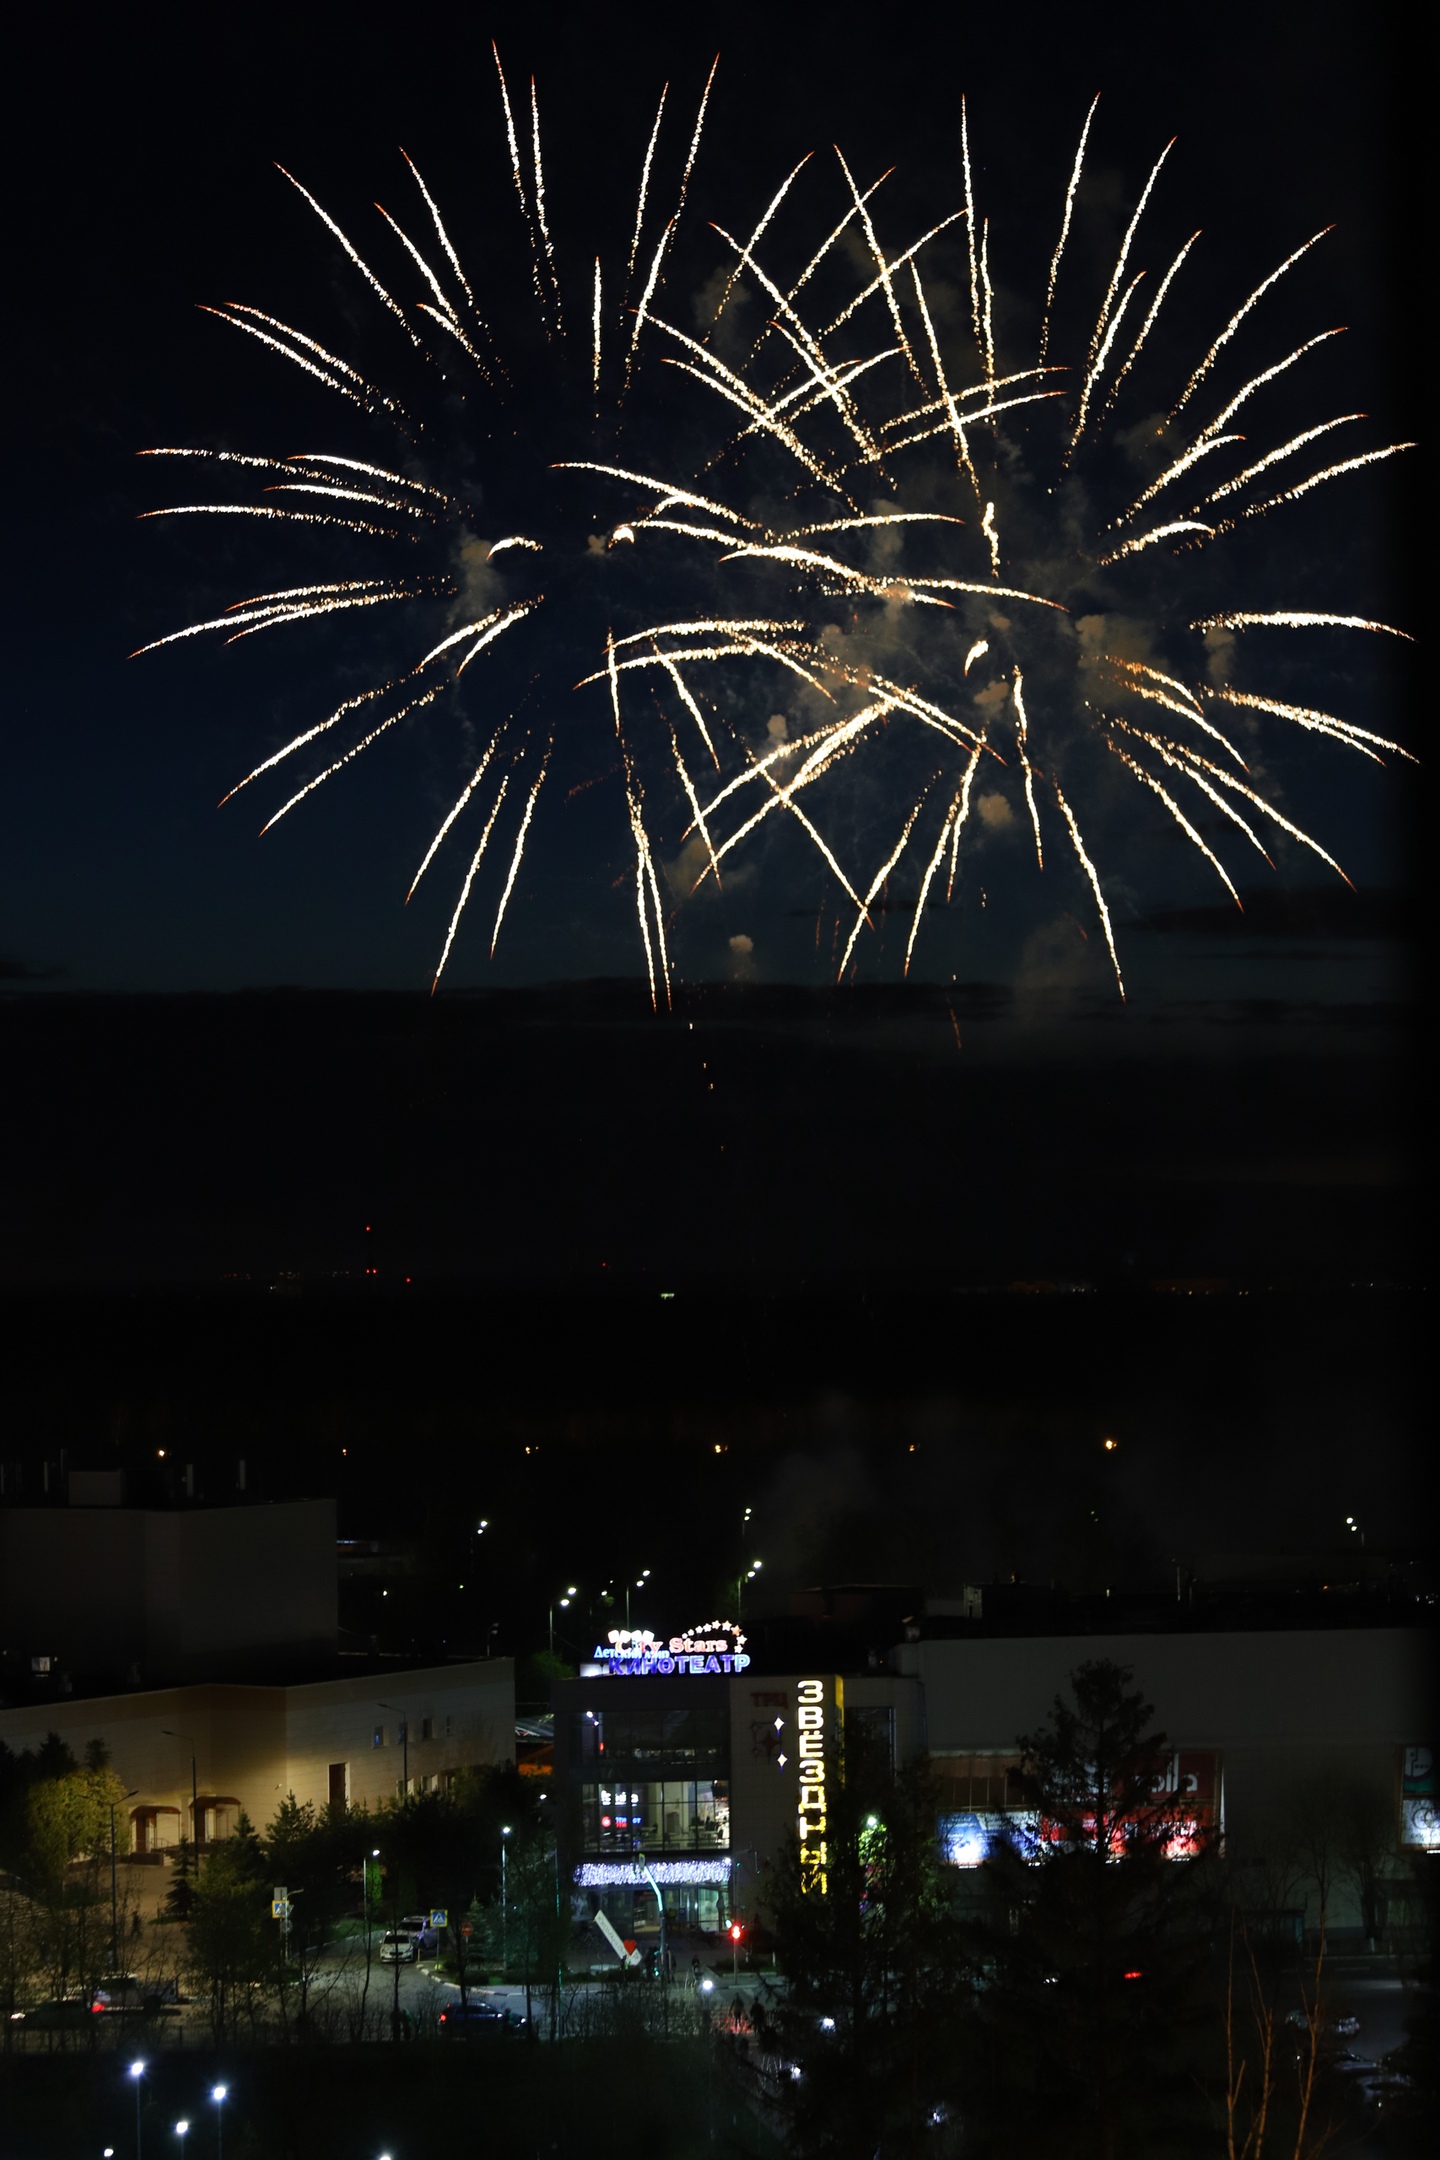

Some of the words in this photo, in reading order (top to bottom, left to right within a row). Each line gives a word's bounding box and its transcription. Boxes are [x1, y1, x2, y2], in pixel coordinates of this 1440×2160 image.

[615, 1640, 663, 1656] City
[669, 1637, 728, 1652] Stars
[609, 1653, 751, 1676] КИНОТЕАТР
[751, 1692, 788, 1709] ТРЦ
[797, 1680, 828, 1895] ЗВЁЗДНЫЙ
